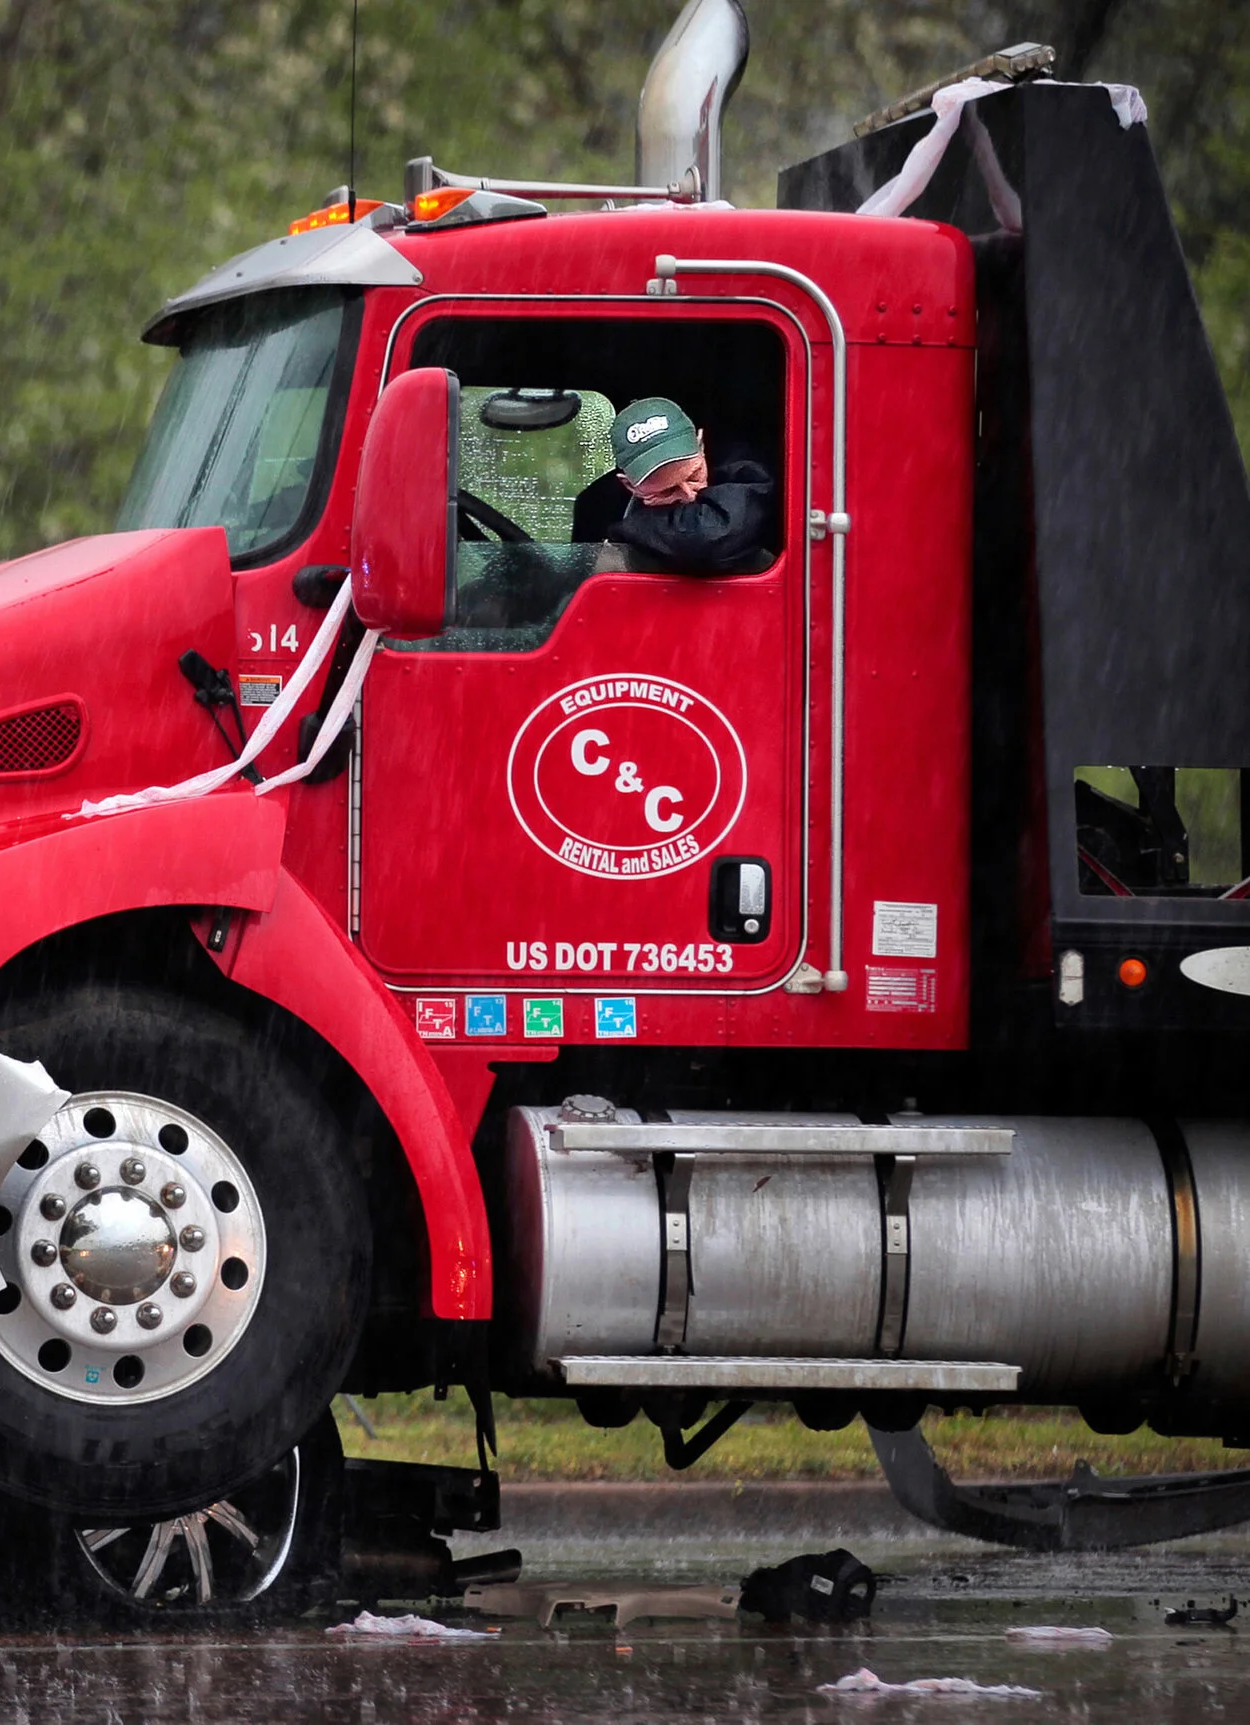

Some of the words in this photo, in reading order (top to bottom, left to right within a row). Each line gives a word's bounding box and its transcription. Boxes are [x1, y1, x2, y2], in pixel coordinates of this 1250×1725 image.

[559, 681, 695, 715] EQUIPMENT
[570, 728, 611, 776] C
[614, 761, 644, 793] &
[644, 785, 685, 833] C
[558, 837, 620, 873] RENTAL
[621, 851, 650, 874] and
[651, 834, 700, 871] SALES
[506, 942, 548, 970] US
[555, 942, 618, 971] DOT
[623, 943, 734, 973] 736453
